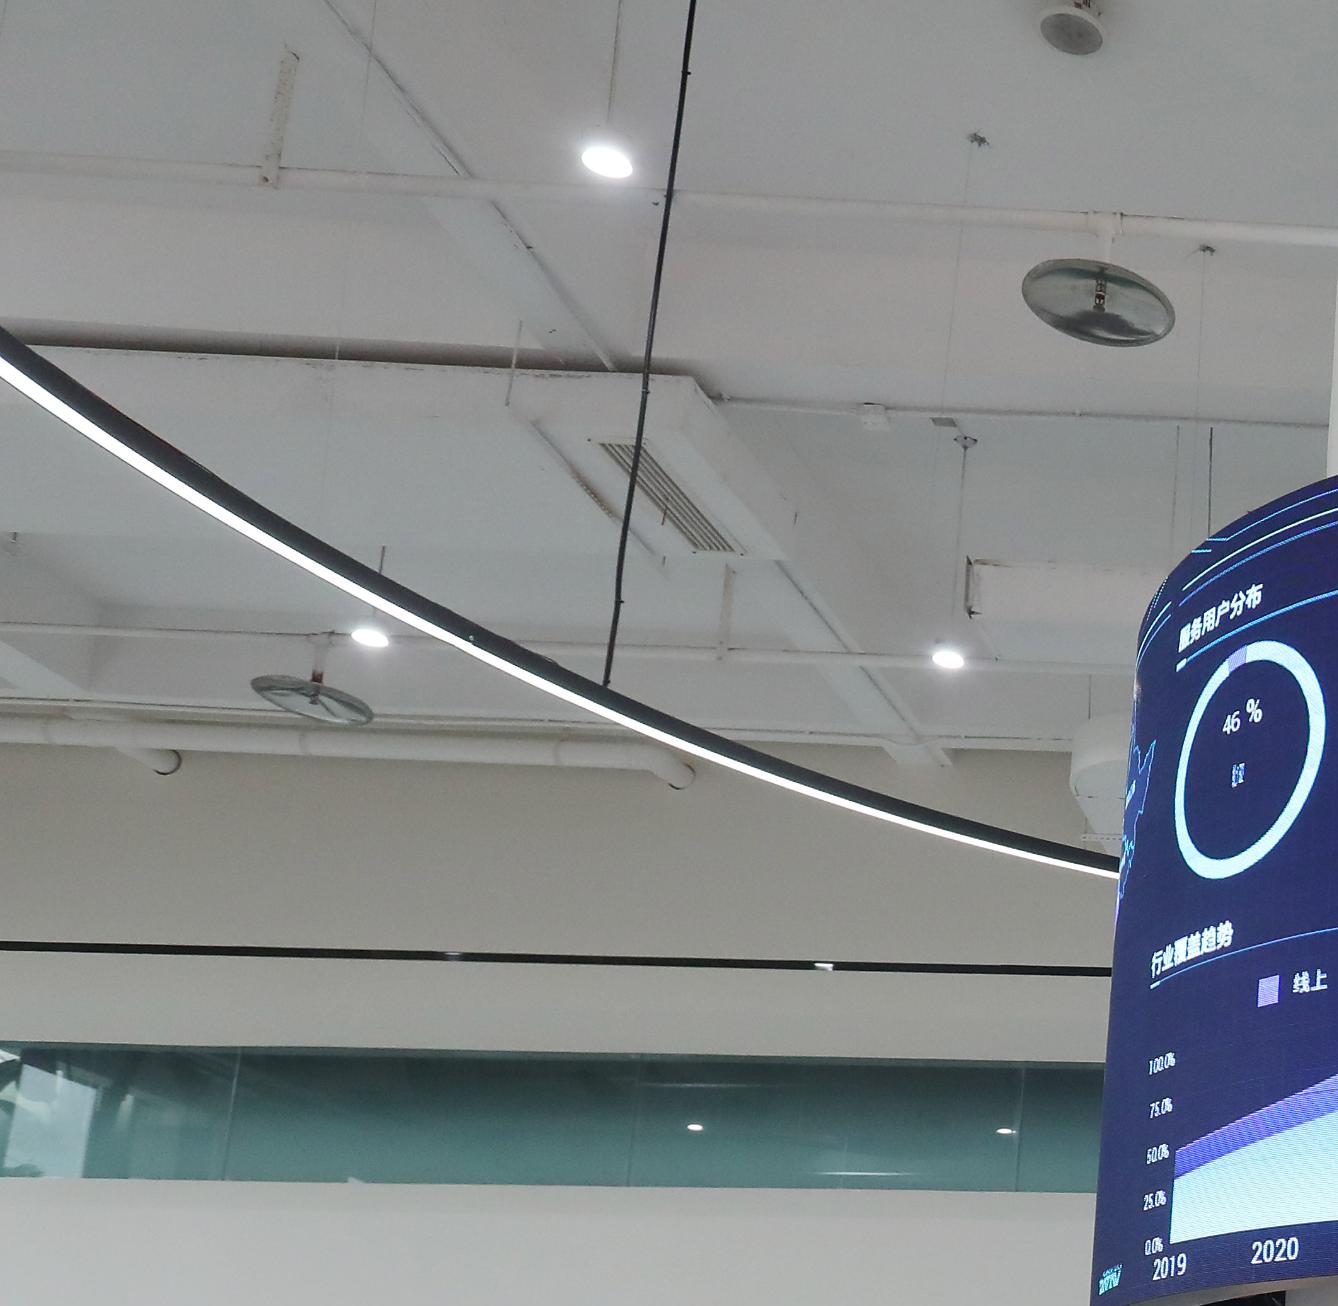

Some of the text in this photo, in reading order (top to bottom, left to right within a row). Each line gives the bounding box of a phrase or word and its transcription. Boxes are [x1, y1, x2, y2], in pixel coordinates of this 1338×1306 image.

[1178, 583, 1263, 653] 服务用户分布
[1222, 698, 1263, 735] 46 %
[1292, 969, 1328, 993] 线上
[1250, 1236, 1300, 1265] 2020
[1152, 1253, 1187, 1280] 2019
